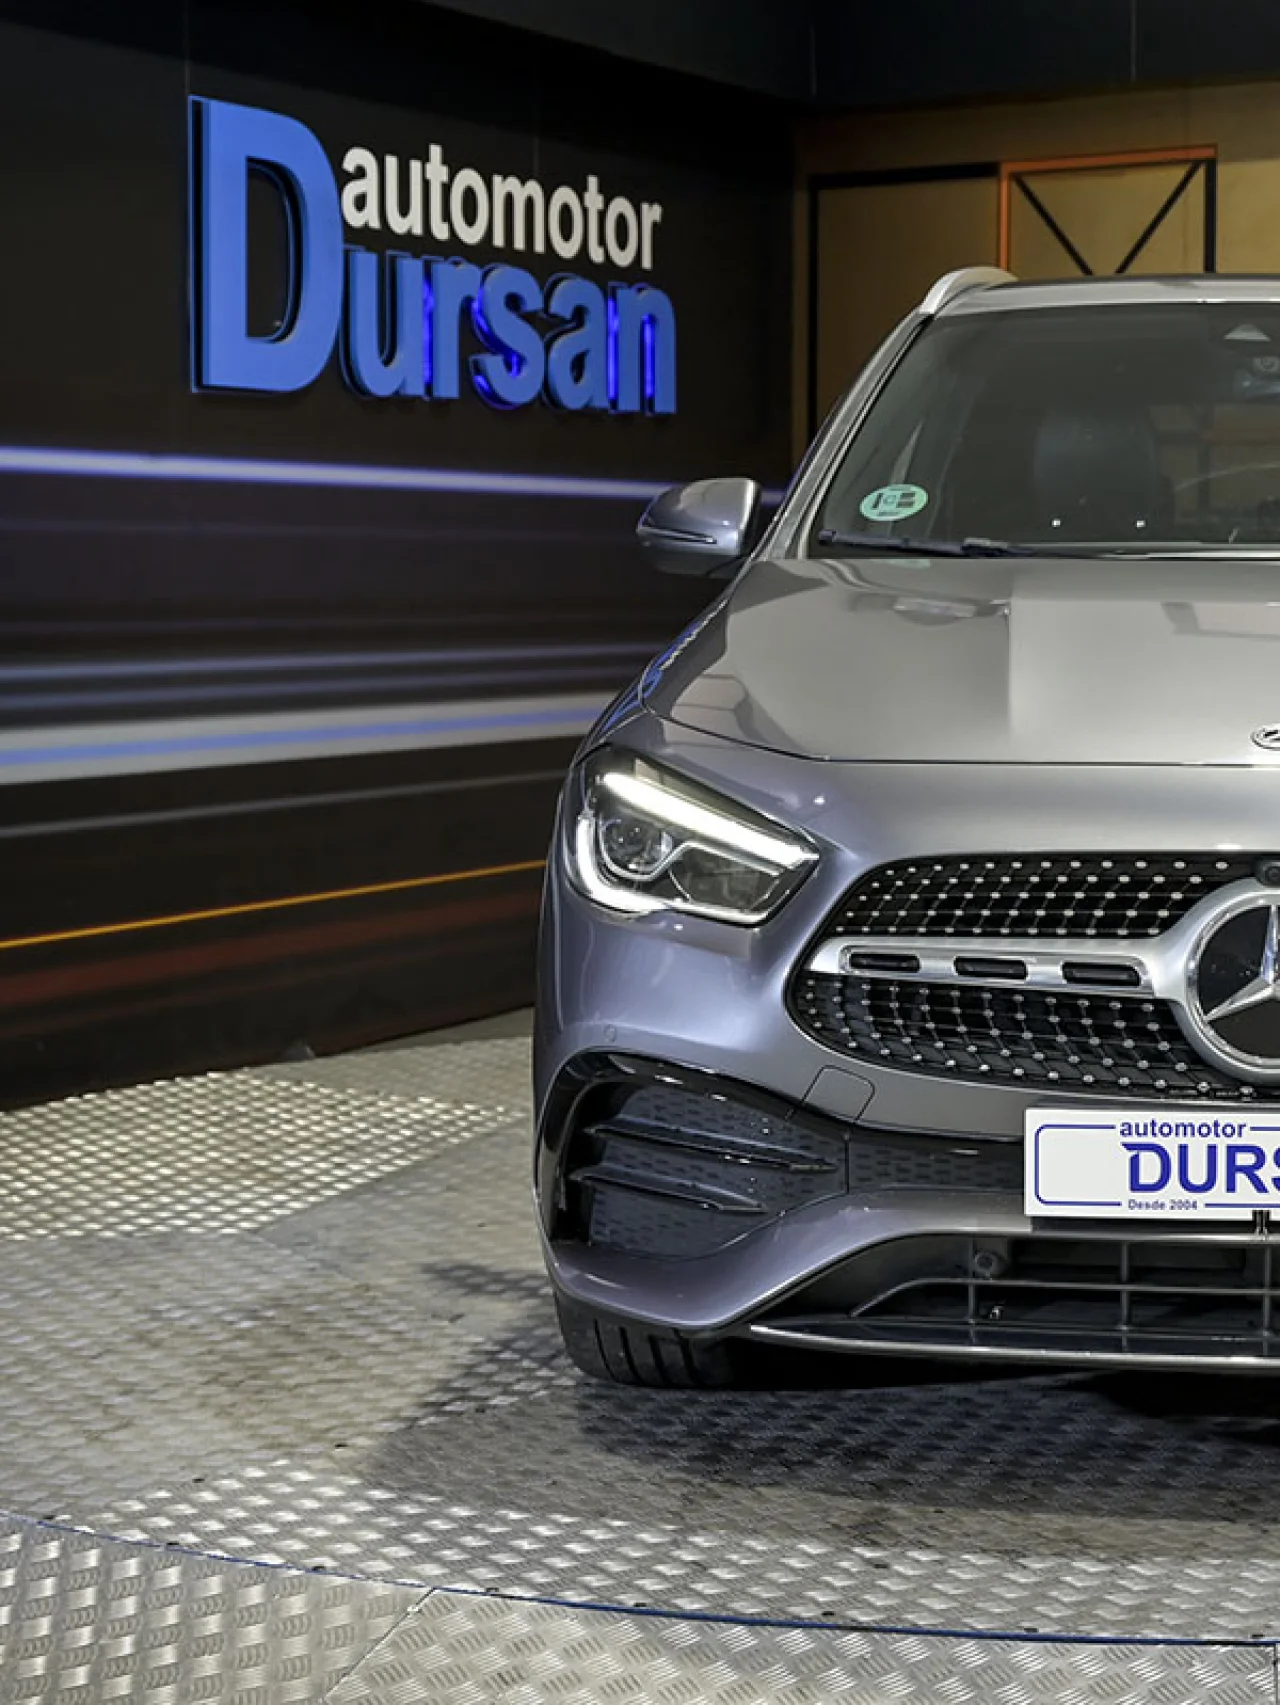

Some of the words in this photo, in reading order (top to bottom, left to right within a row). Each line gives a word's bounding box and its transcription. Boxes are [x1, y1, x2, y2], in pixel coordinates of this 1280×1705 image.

[341, 143, 662, 270] automotor
[188, 94, 677, 415] Dursan
[1120, 1117, 1247, 1138] automotor
[1128, 1199, 1165, 1211] Desde
